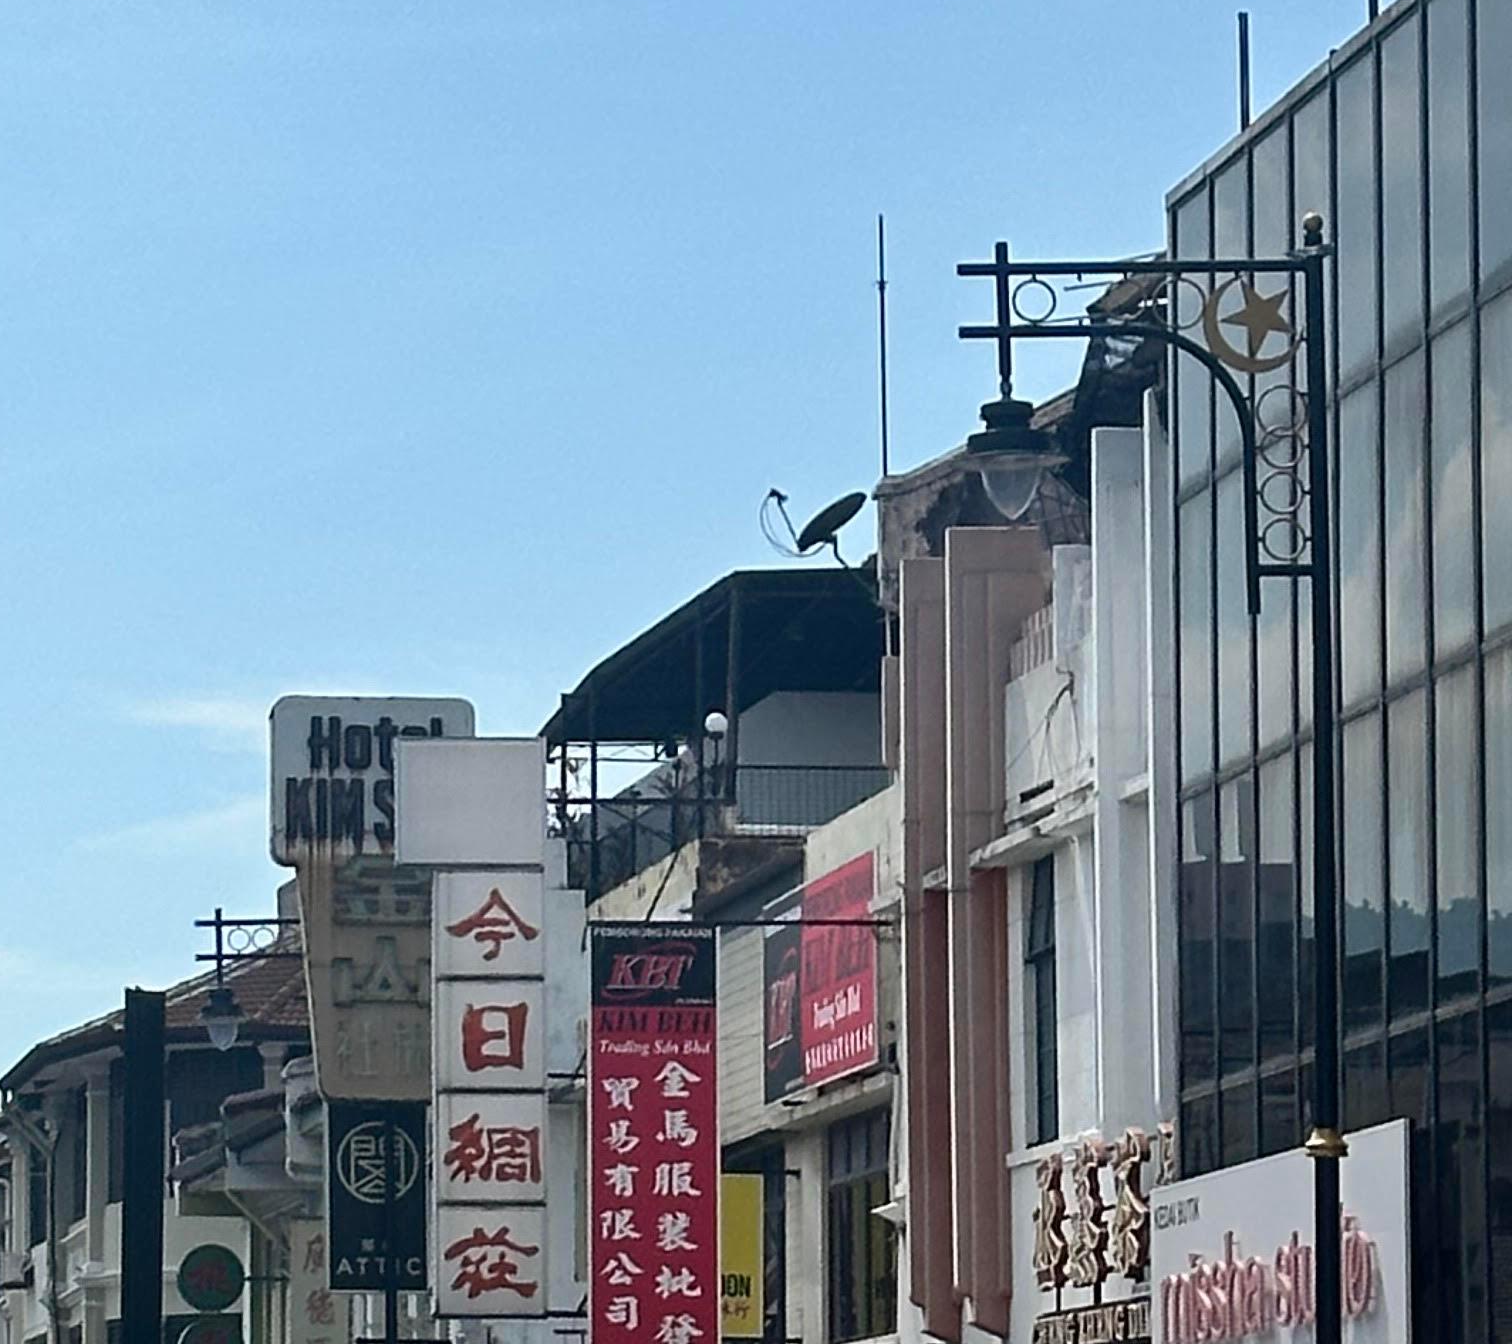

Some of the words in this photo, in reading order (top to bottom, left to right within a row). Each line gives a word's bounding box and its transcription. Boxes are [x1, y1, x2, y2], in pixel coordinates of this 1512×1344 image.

[308, 716, 442, 772] Hot
[286, 777, 365, 846] KIM
[654, 1039, 679, 1055] Sdn
[336, 1257, 421, 1275] ATTIC
